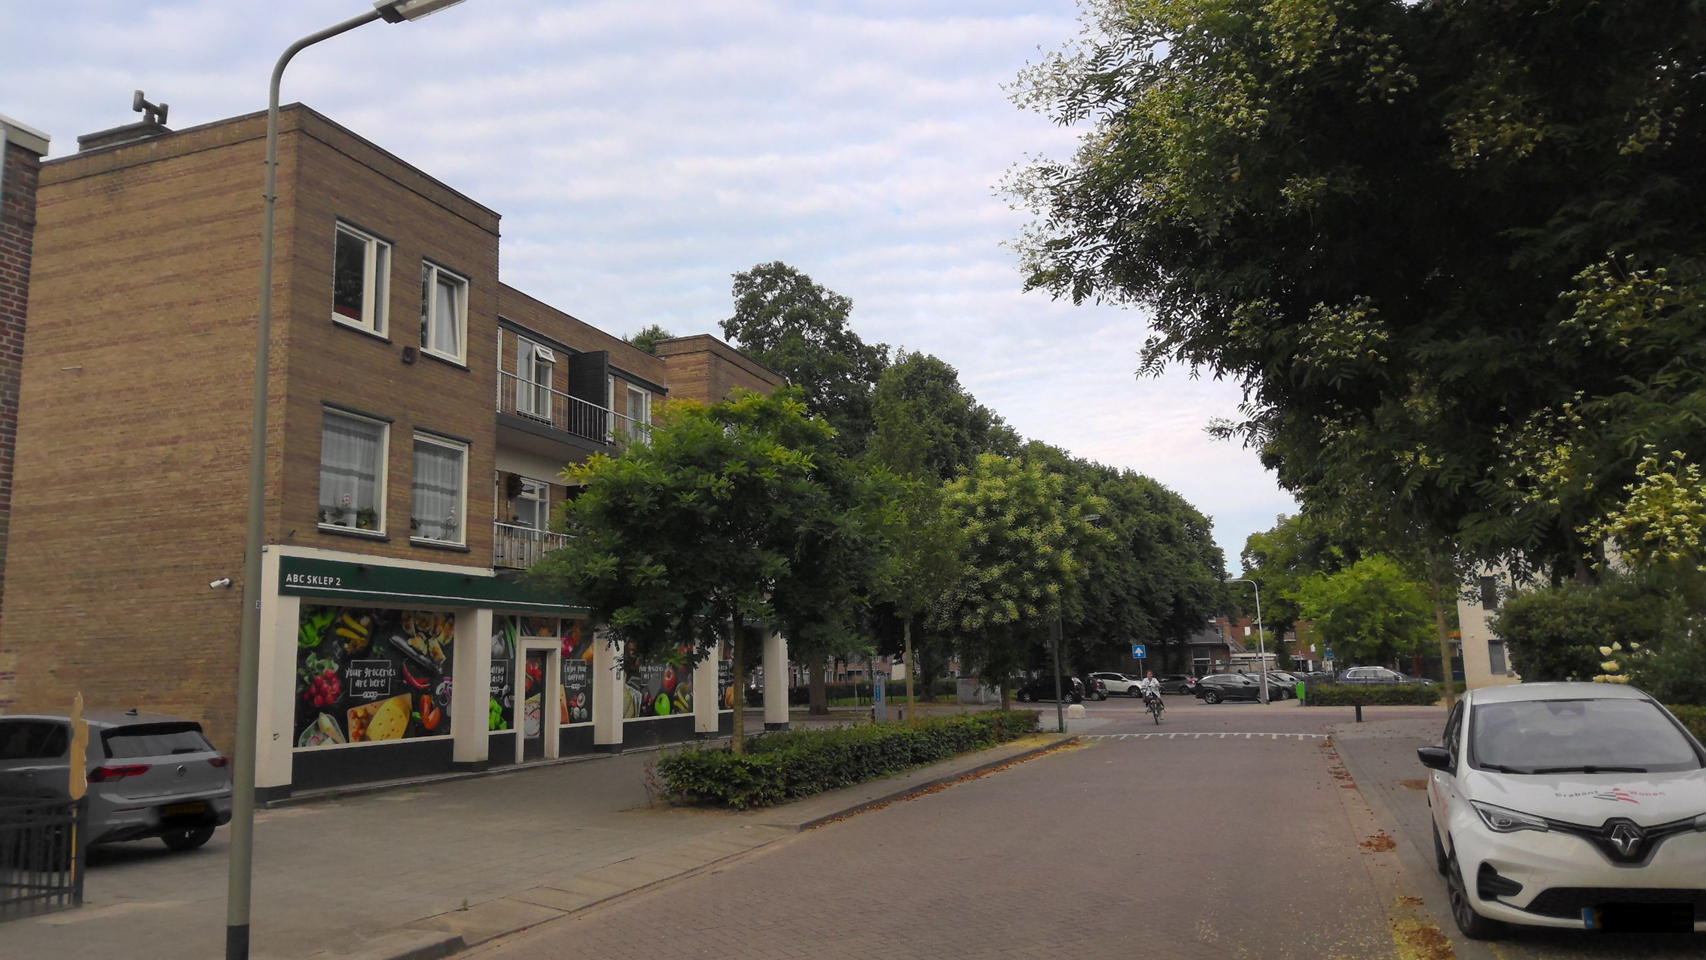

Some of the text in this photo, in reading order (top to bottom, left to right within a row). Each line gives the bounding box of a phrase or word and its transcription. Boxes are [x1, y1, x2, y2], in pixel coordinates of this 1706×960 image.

[286, 573, 341, 586] ABC SKLEP 2
[344, 666, 396, 679] your groceries
[354, 679, 368, 688] are
